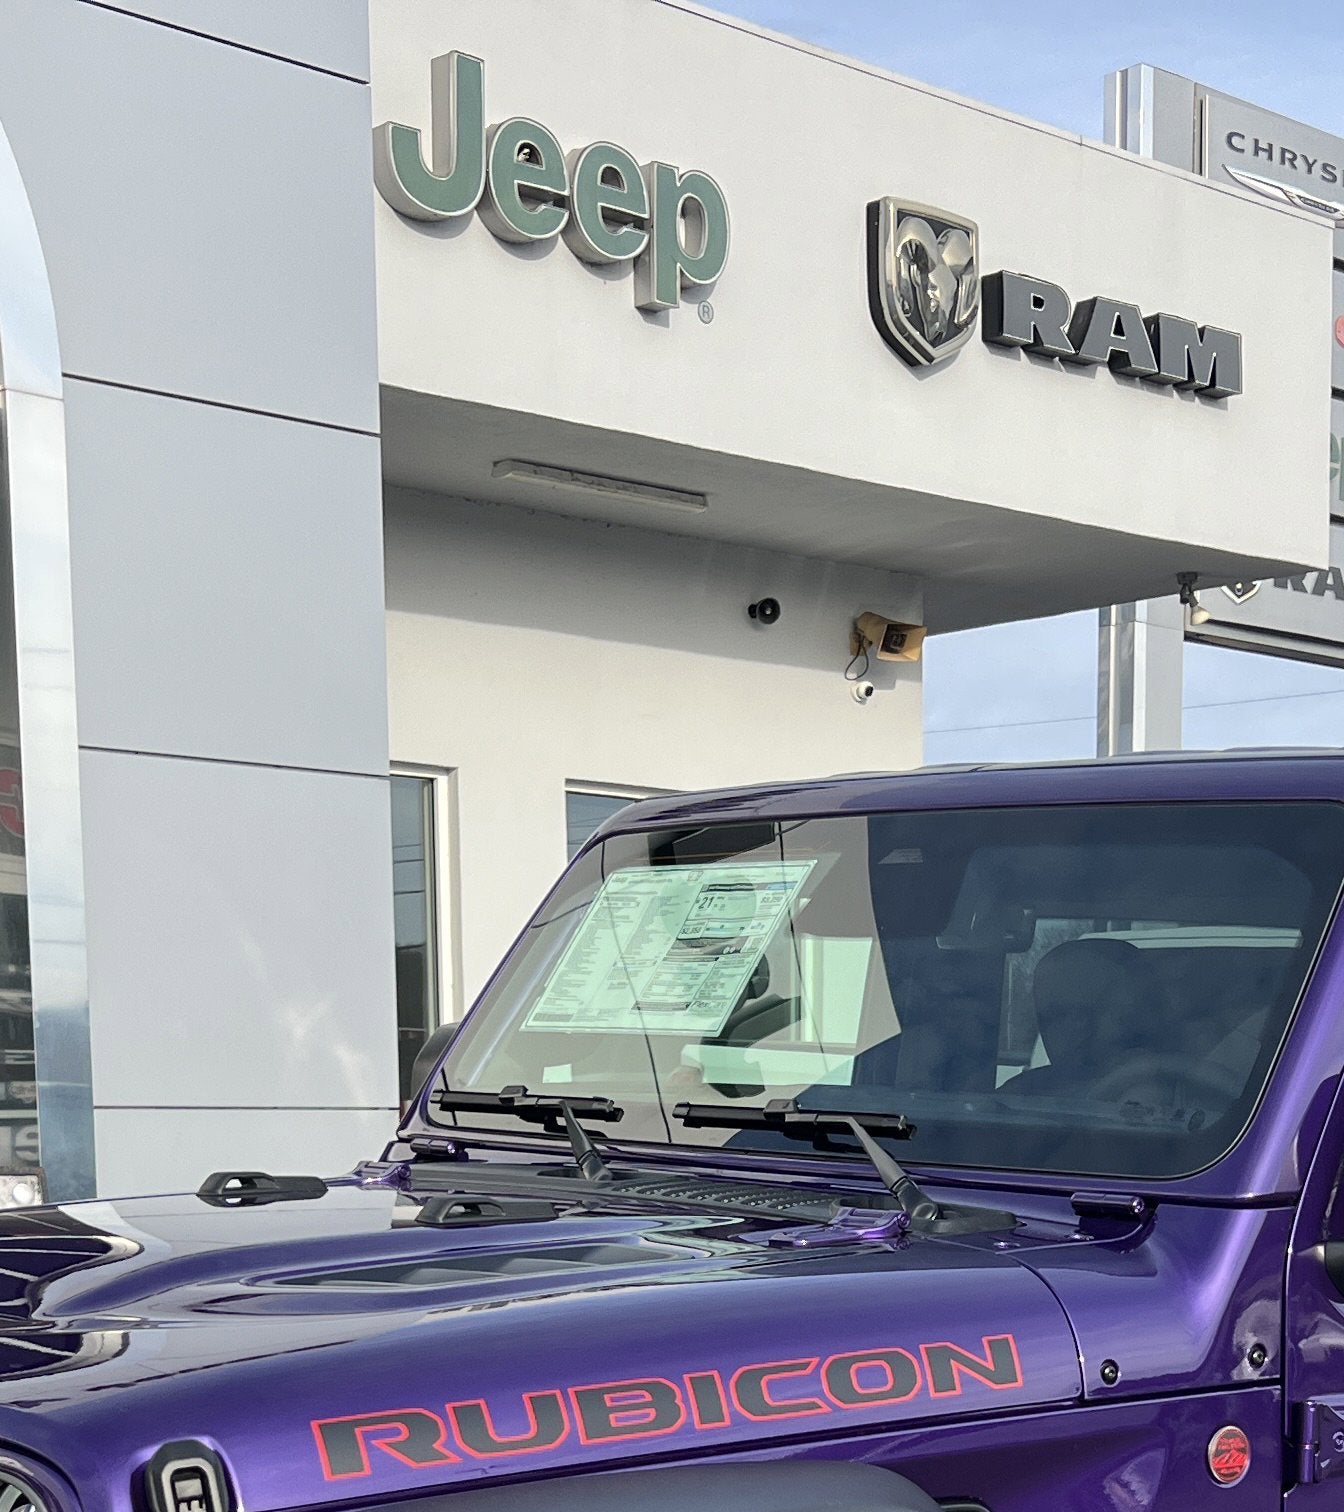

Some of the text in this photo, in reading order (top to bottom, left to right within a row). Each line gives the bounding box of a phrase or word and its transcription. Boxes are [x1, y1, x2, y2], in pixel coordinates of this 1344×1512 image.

[373, 49, 730, 310] Jeep
[981, 270, 1242, 399] RAM
[310, 1334, 1023, 1481] RUBICON
